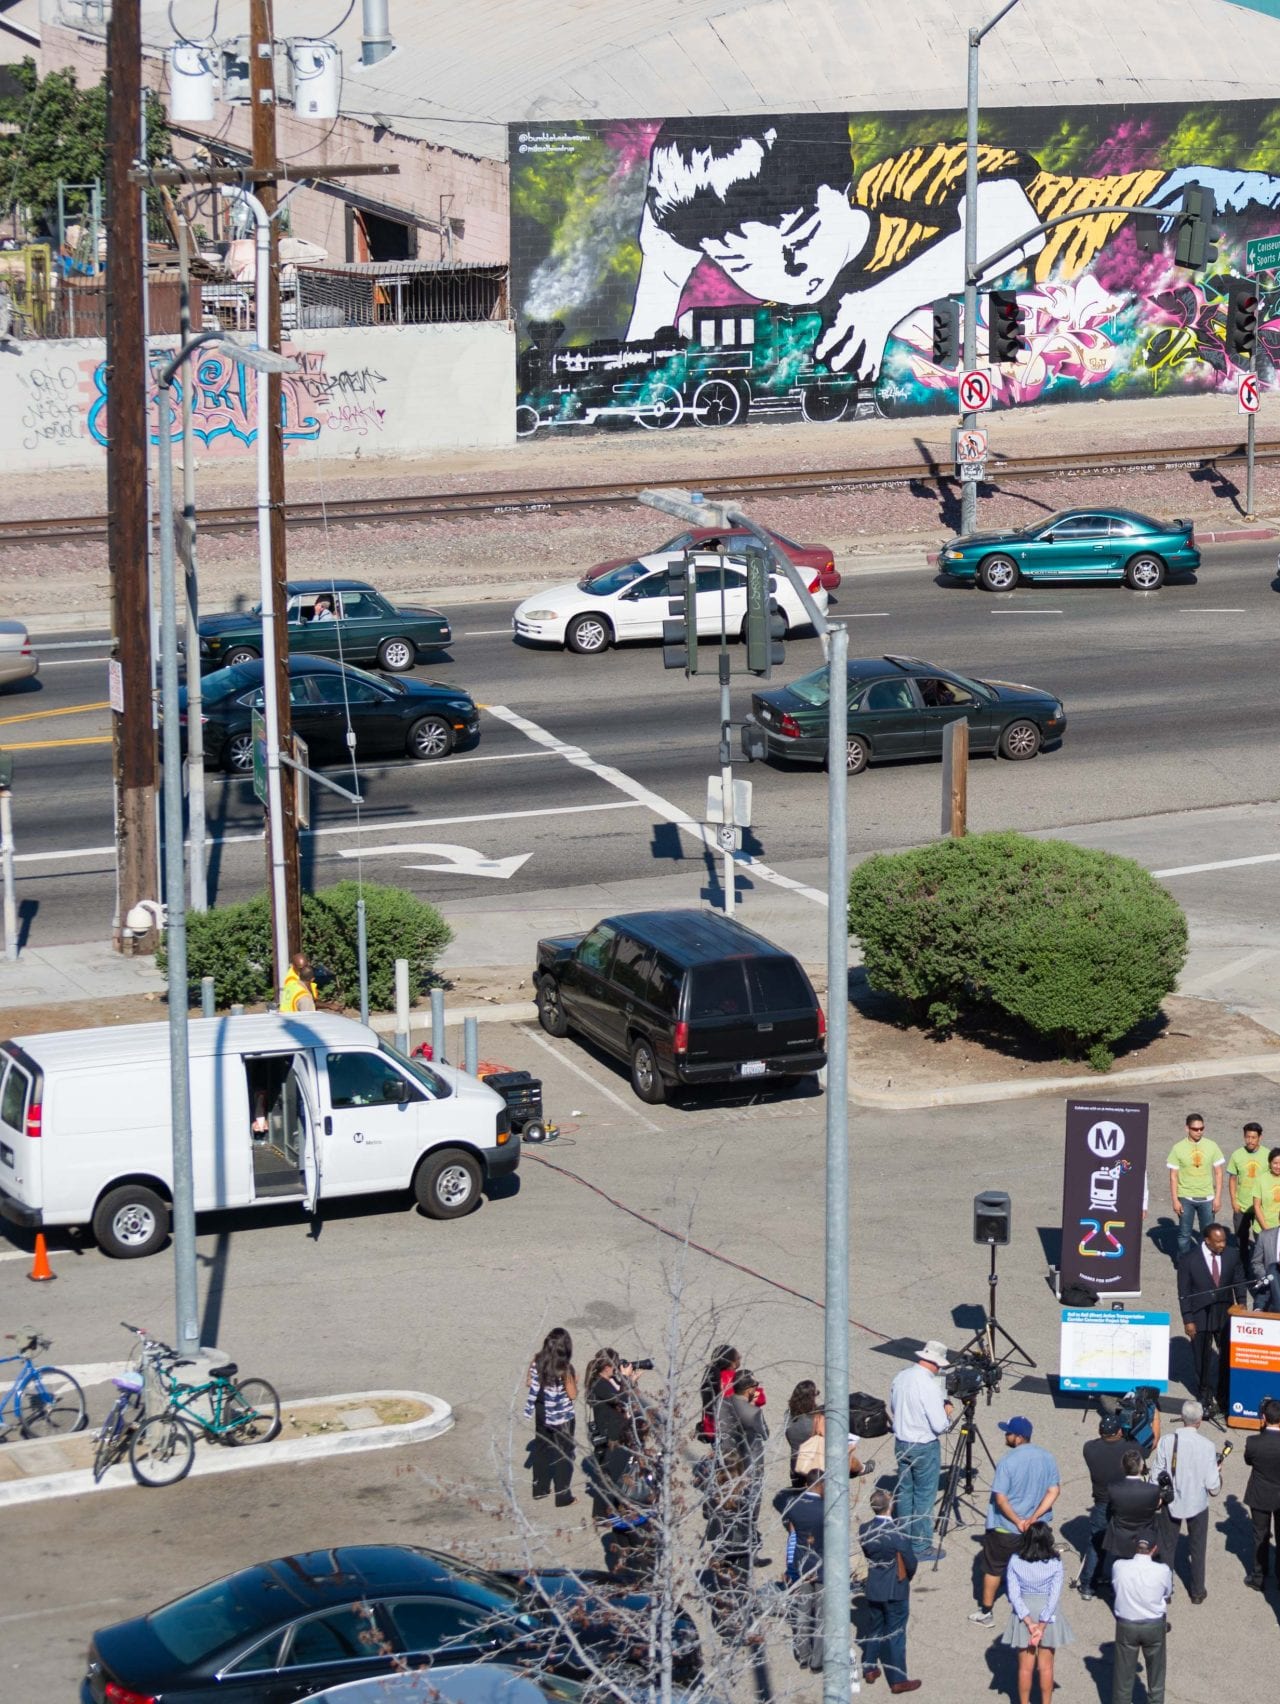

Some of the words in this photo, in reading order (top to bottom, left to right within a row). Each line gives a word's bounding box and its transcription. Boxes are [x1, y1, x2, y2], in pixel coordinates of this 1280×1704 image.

[1256, 254, 1276, 266] Sports
[1095, 1128, 1118, 1150] M
[1079, 1218, 1125, 1258] 25
[1236, 1325, 1264, 1336] TIGER
